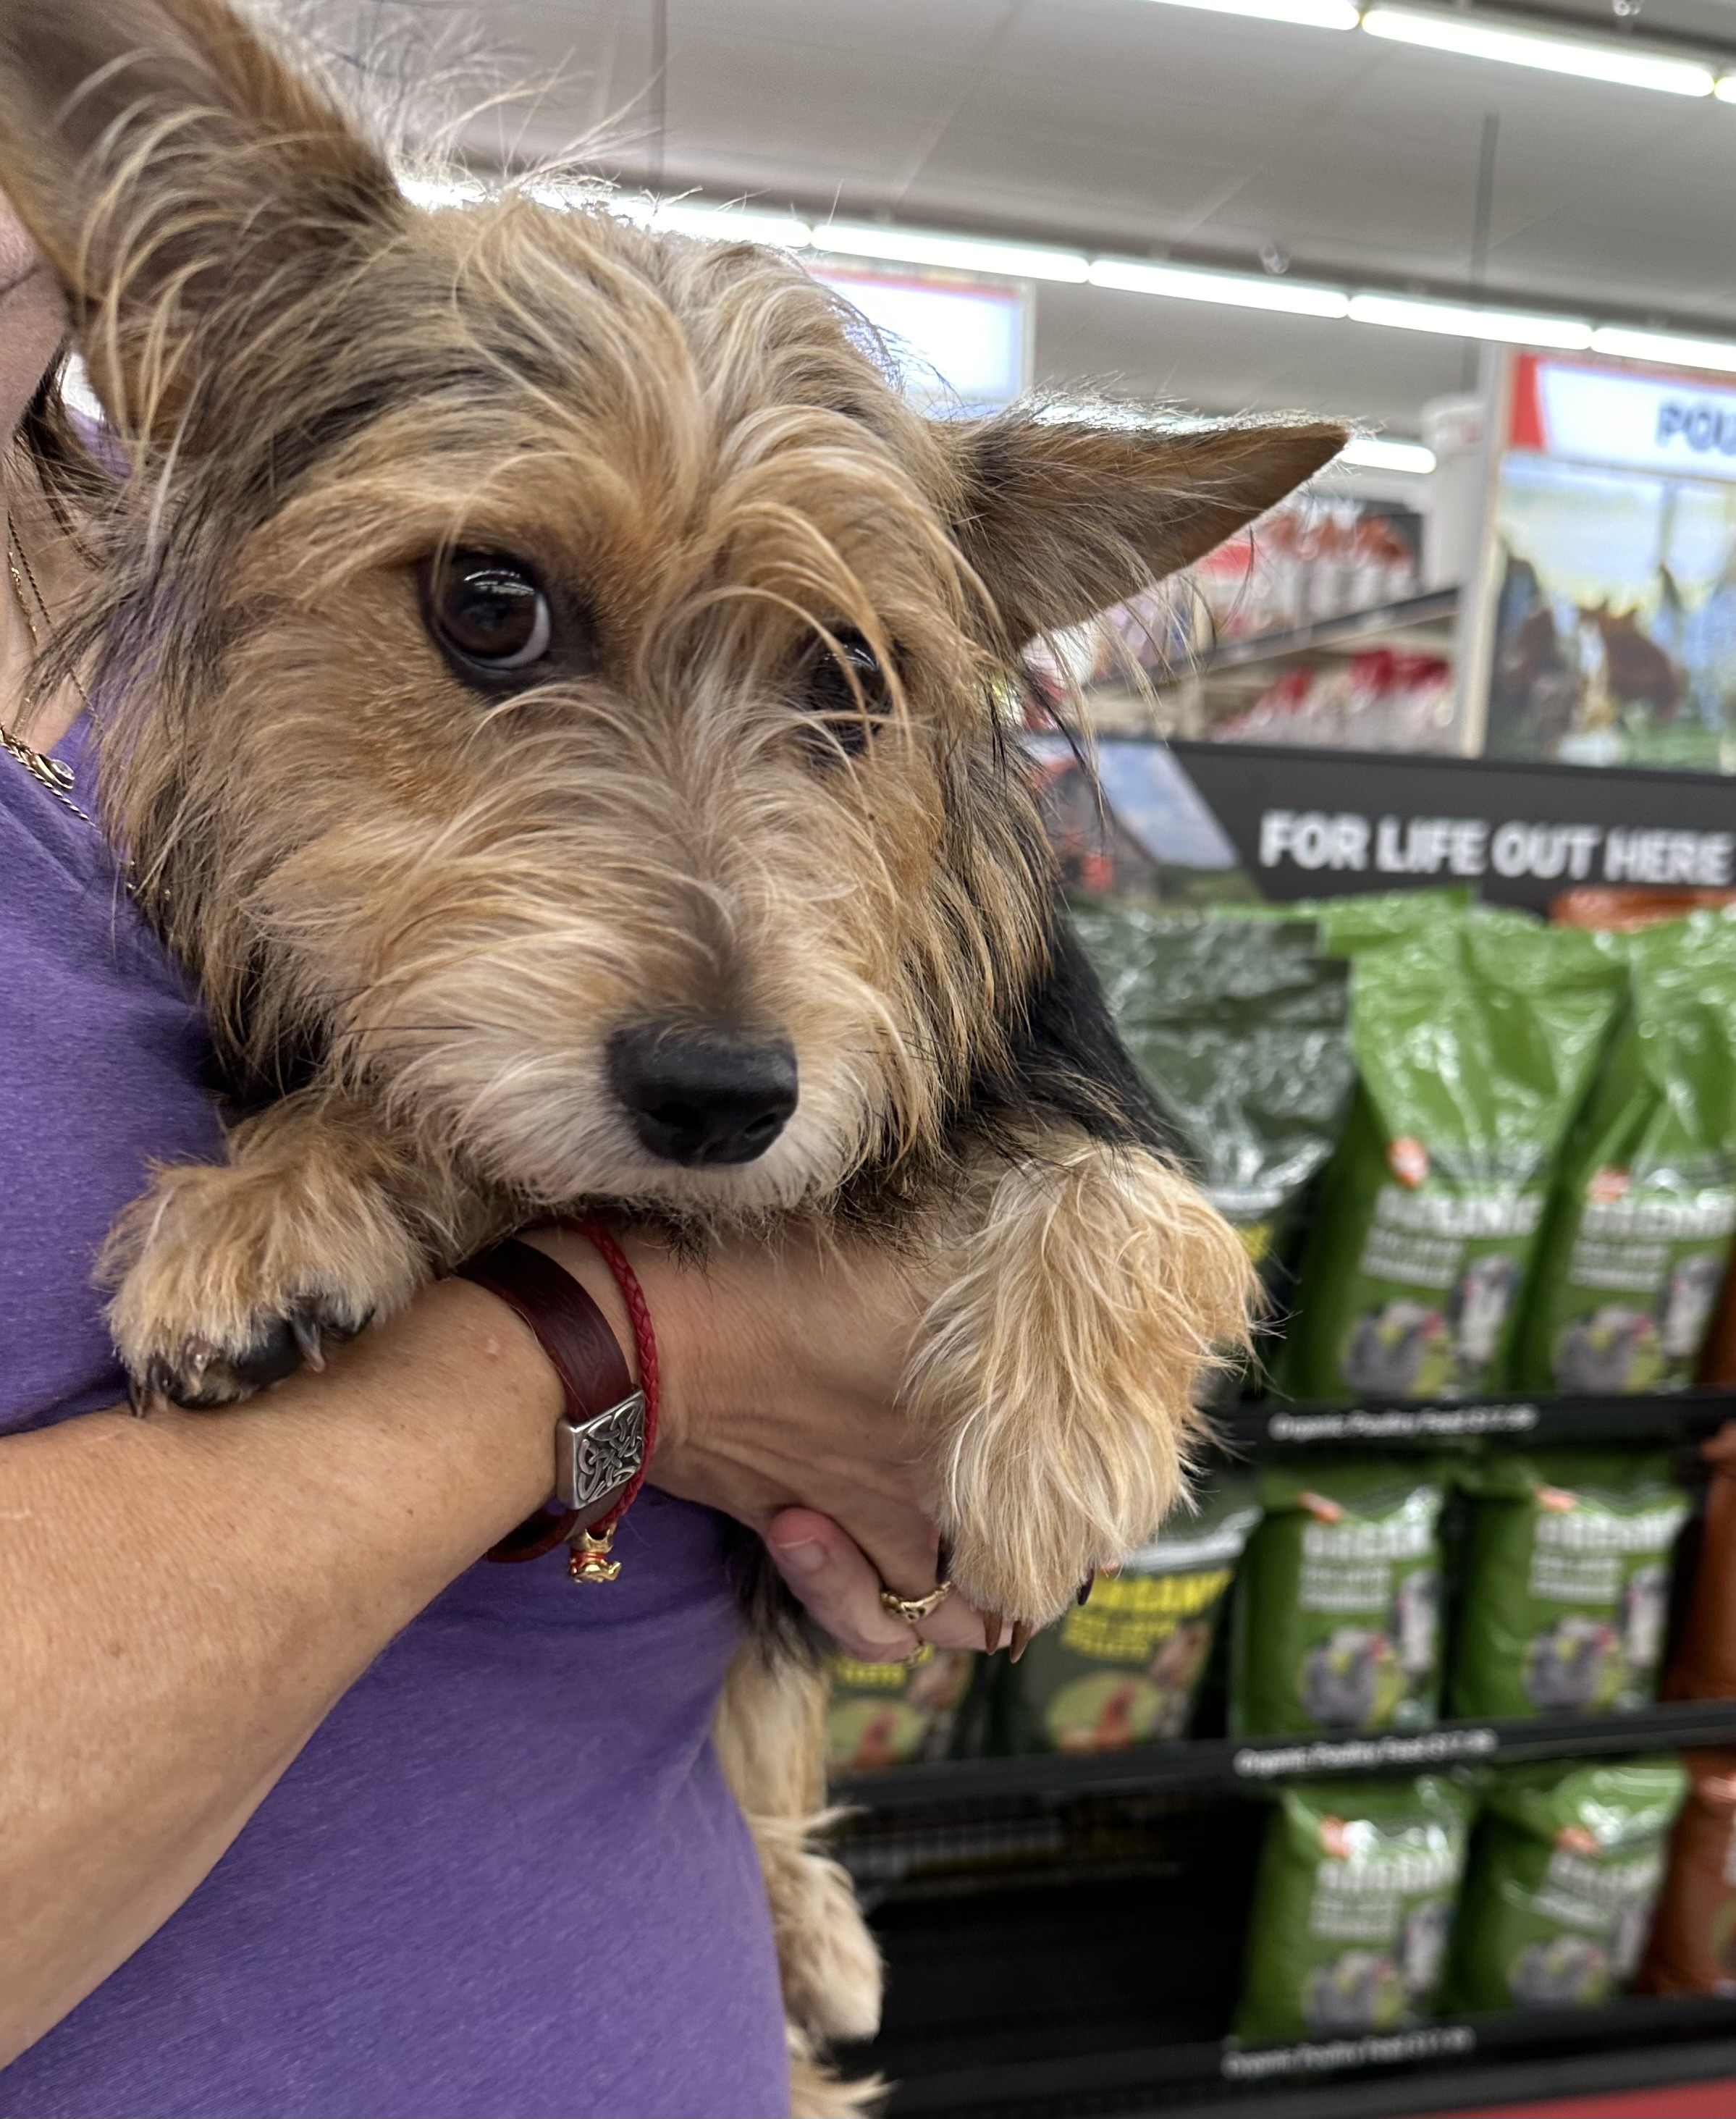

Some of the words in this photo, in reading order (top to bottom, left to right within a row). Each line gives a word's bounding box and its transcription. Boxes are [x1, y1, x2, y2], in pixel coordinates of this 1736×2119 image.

[1260, 809, 1370, 870] FOR
[1376, 814, 1489, 875] LIFE
[1491, 820, 1601, 879] OUT
[1604, 826, 1735, 885] HERE
